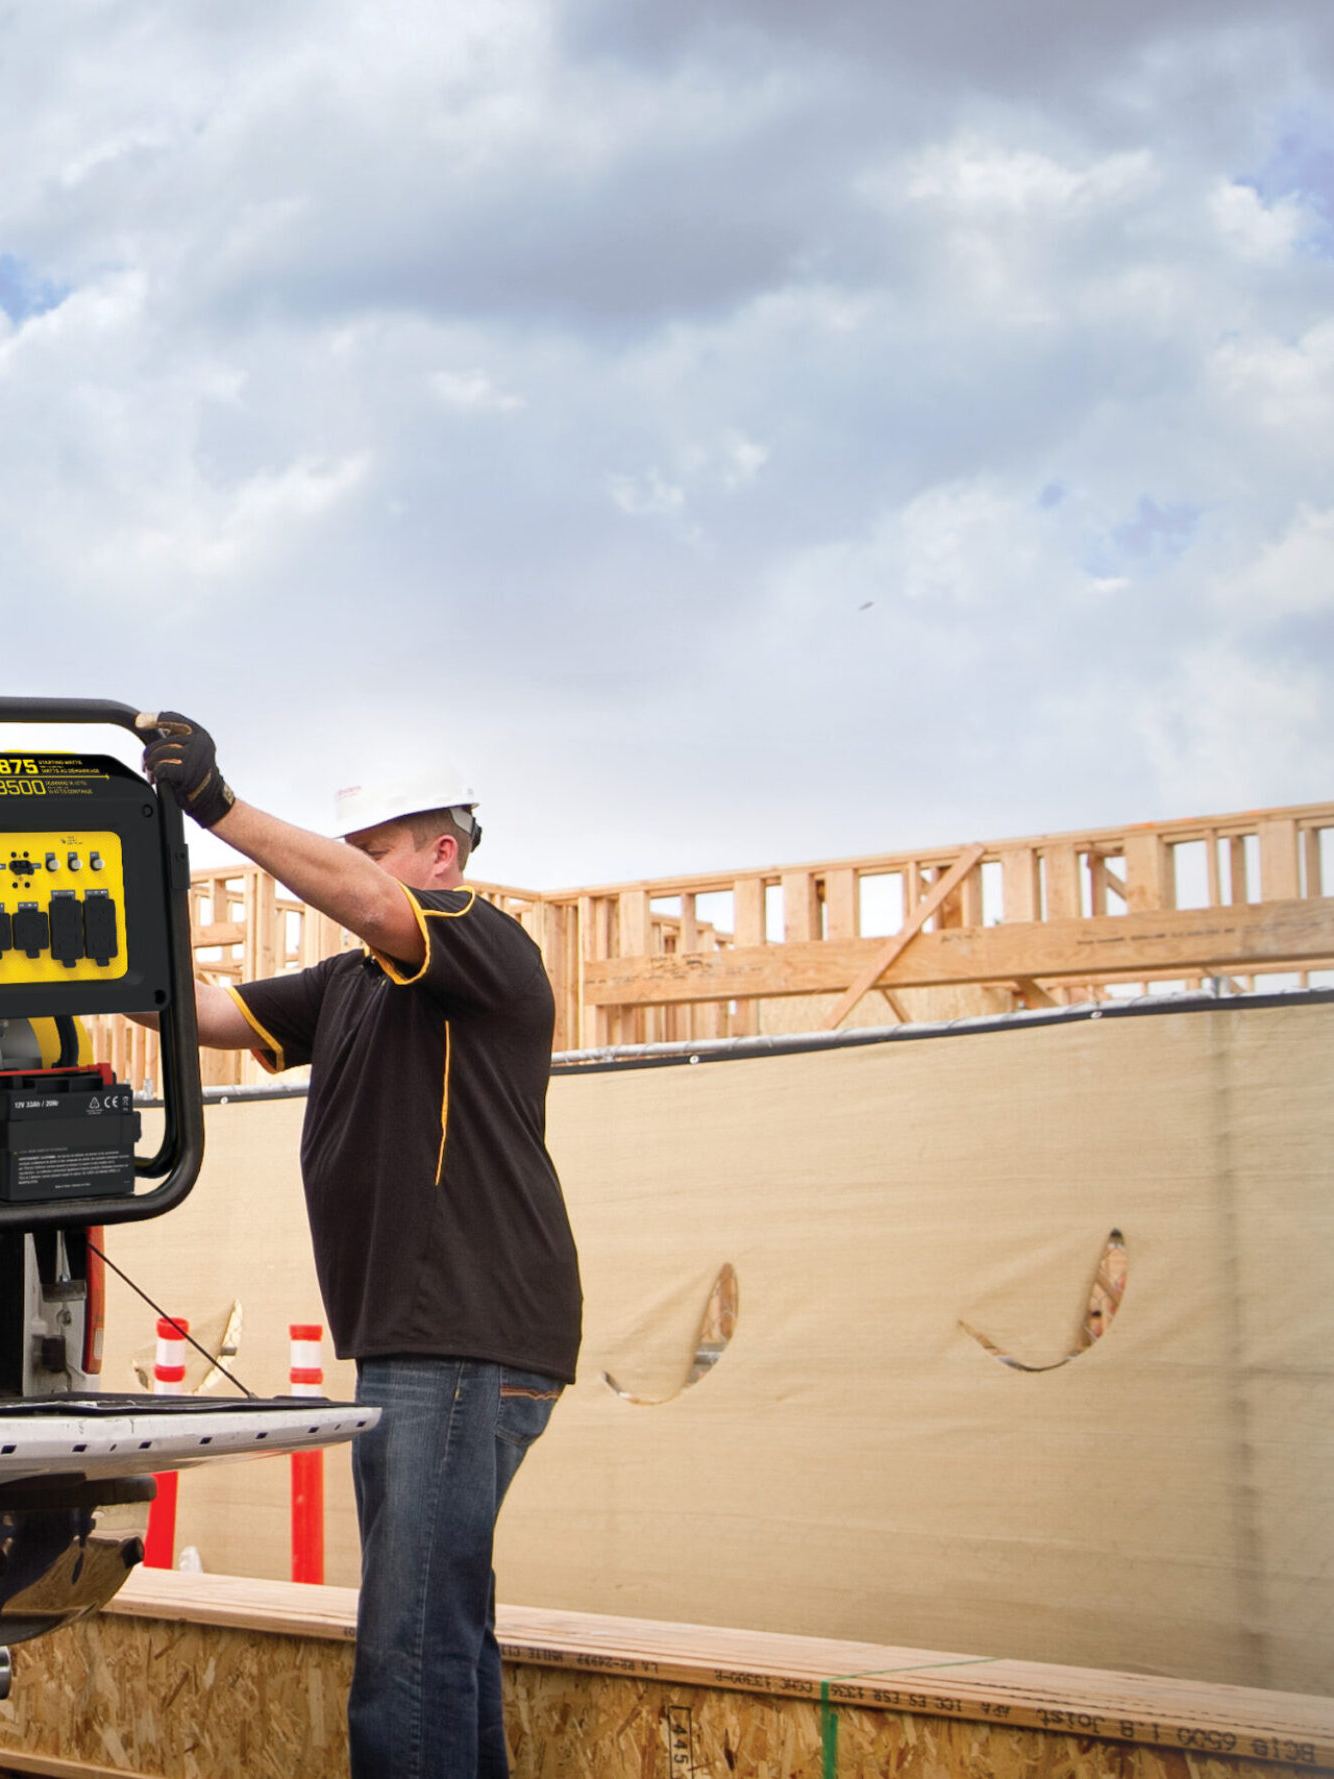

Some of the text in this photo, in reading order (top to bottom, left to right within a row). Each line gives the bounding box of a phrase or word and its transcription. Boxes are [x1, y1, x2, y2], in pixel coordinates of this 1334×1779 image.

[642, 1660, 659, 1673] LA
[831, 1683, 865, 1699] 1336
[873, 1688, 900, 1704] ESR
[908, 1693, 927, 1708] ES
[934, 1696, 963, 1712] ICC
[1037, 1708, 1106, 1734] Joist
[673, 1724, 689, 1765] 445
[1177, 1725, 1238, 1751] 6500
